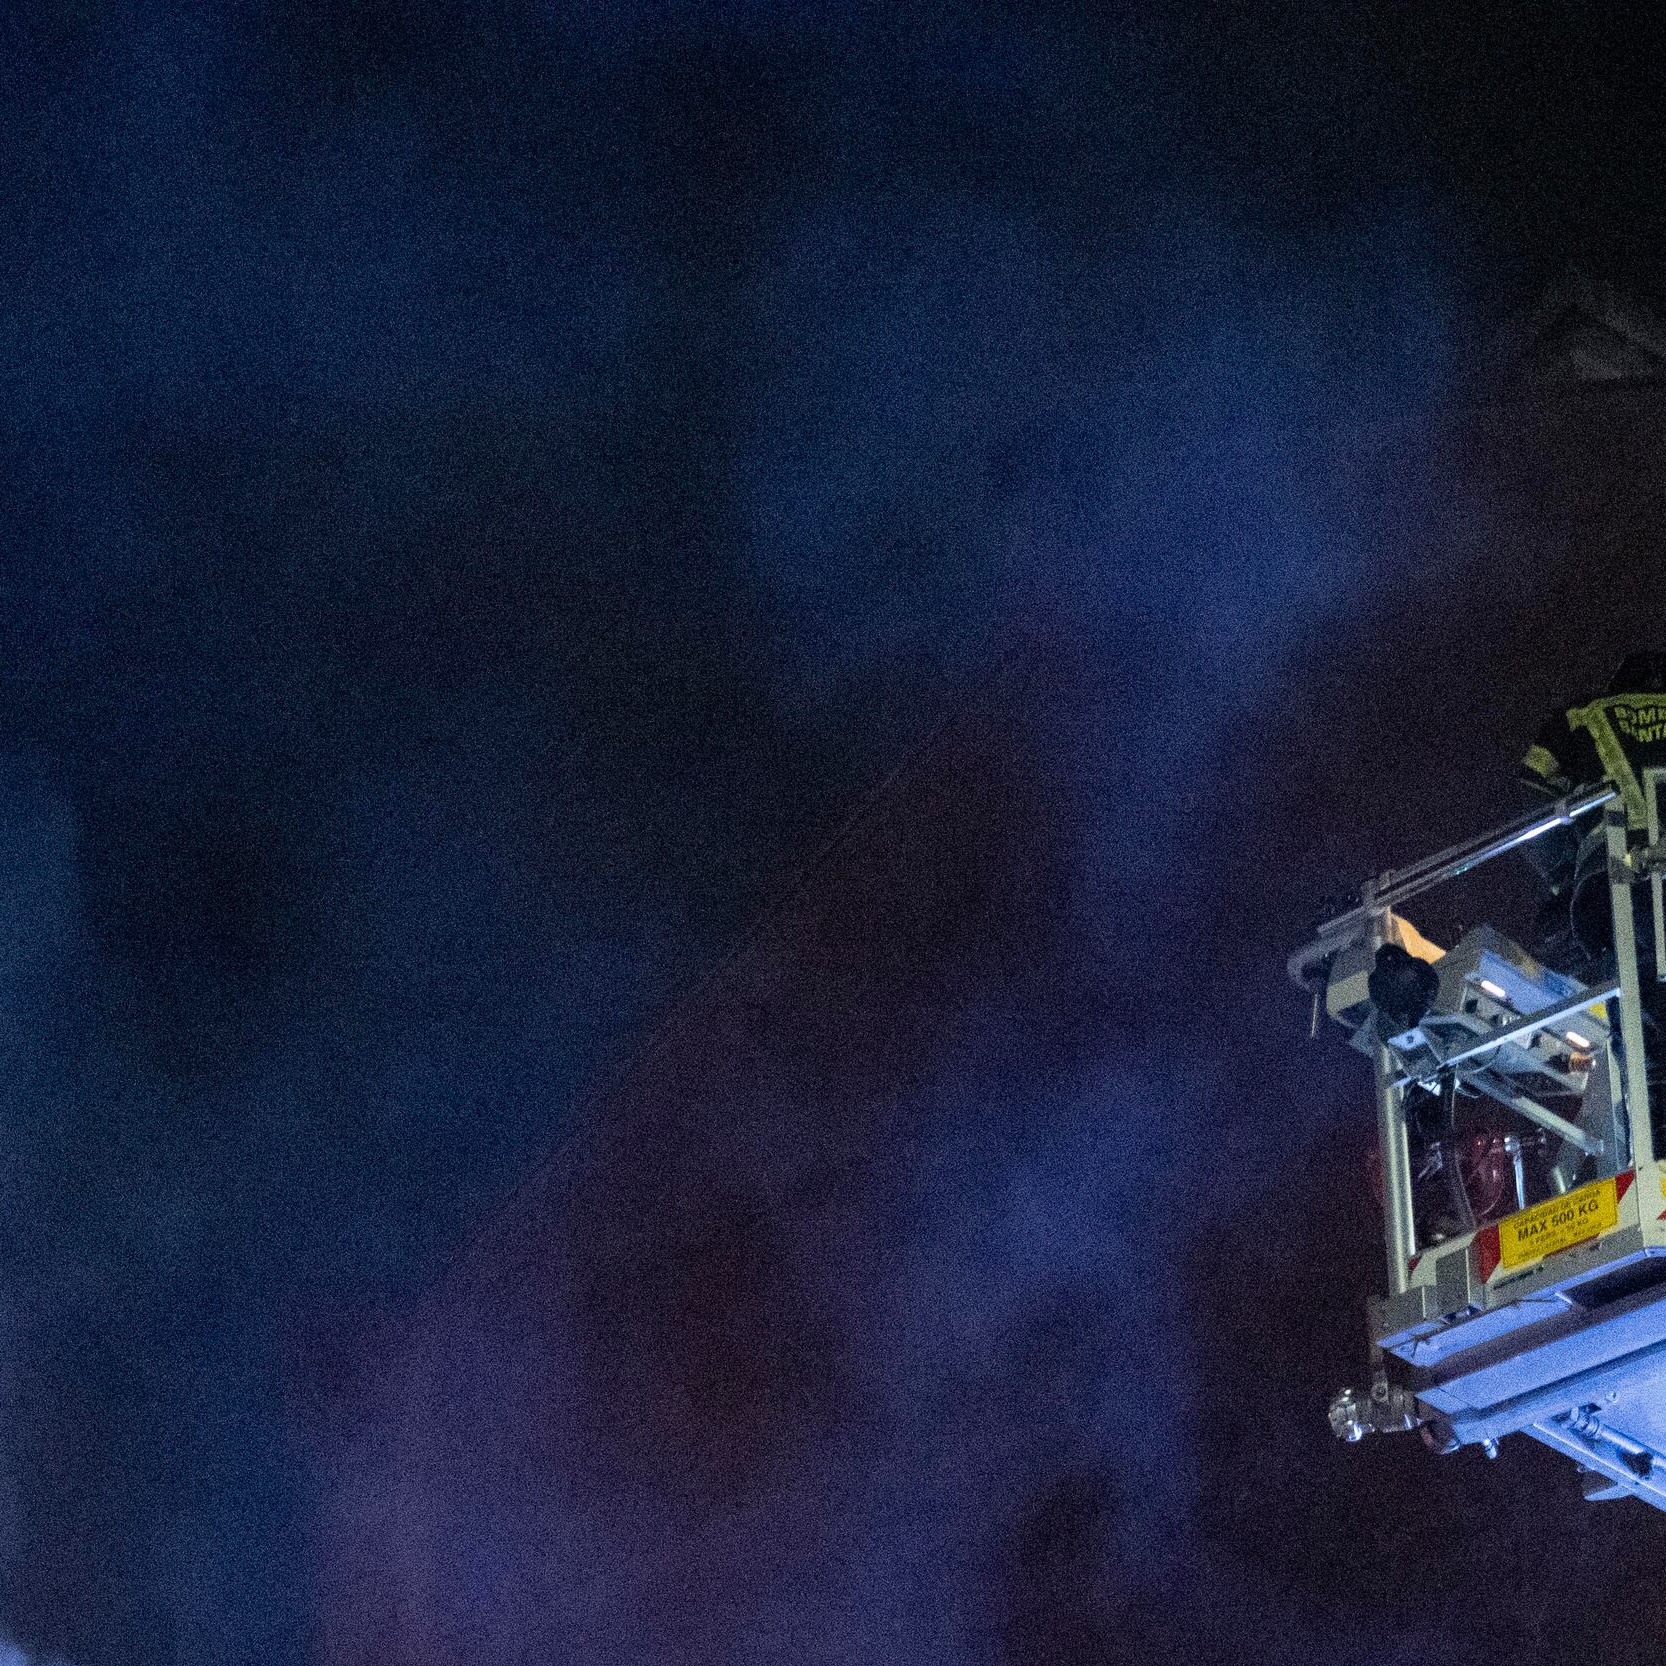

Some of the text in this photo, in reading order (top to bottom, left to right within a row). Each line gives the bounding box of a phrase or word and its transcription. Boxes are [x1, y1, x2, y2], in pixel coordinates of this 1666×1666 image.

[1518, 1219, 1547, 1241] MAX
[1551, 1208, 1575, 1227] 500
[1578, 1199, 1599, 1216] KG
